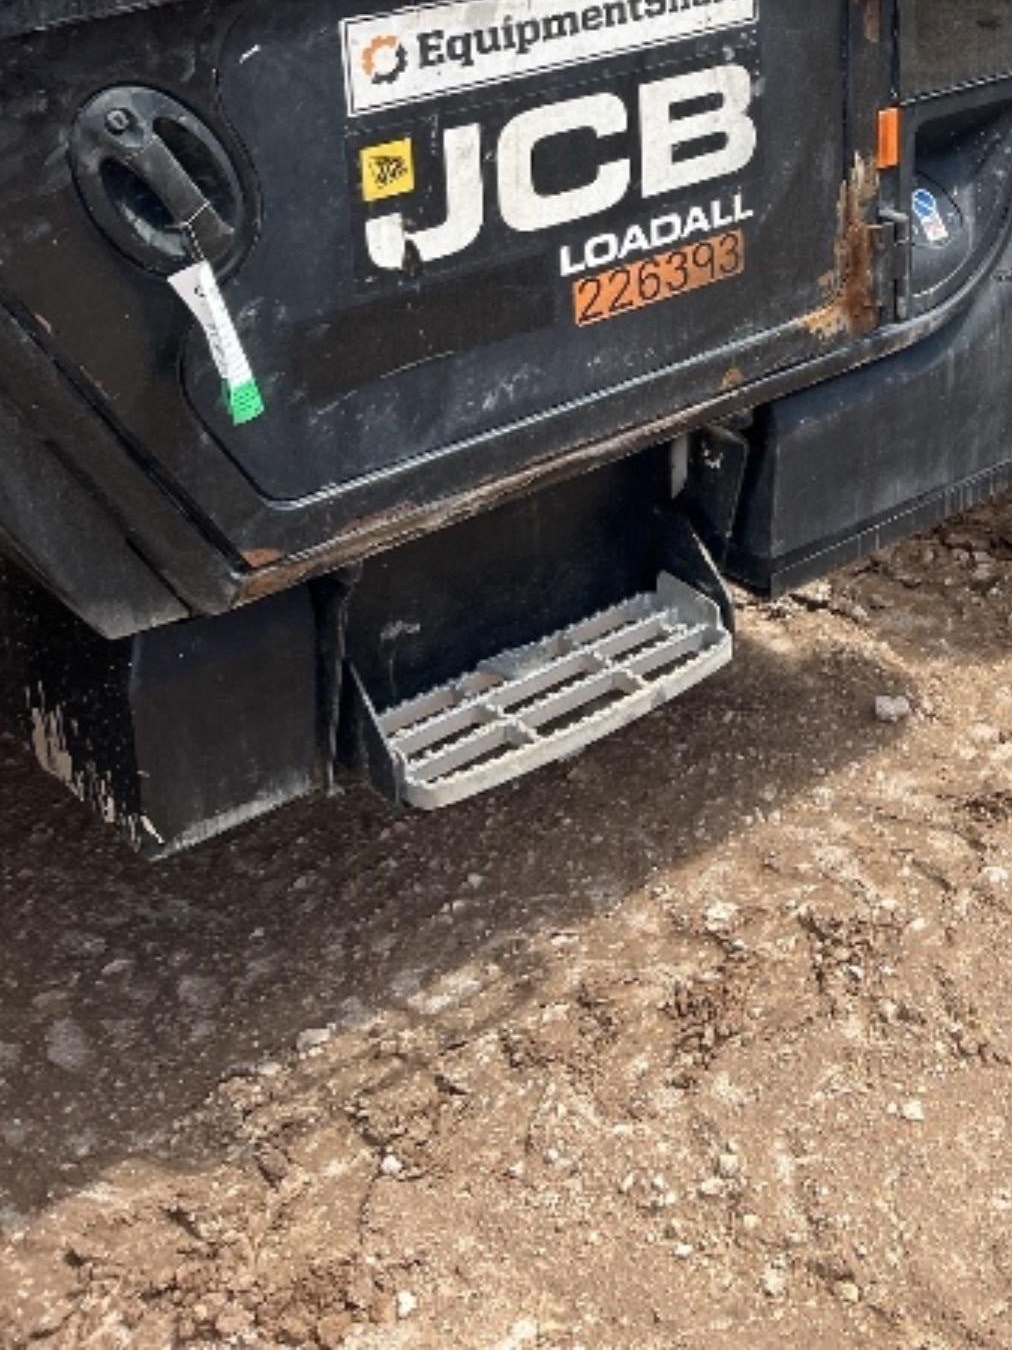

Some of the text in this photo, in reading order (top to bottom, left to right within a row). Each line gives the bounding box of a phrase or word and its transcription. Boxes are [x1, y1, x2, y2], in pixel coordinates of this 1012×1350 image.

[365, 63, 757, 269] JCB
[560, 192, 754, 276] LOADALL
[577, 233, 741, 323] 226393
